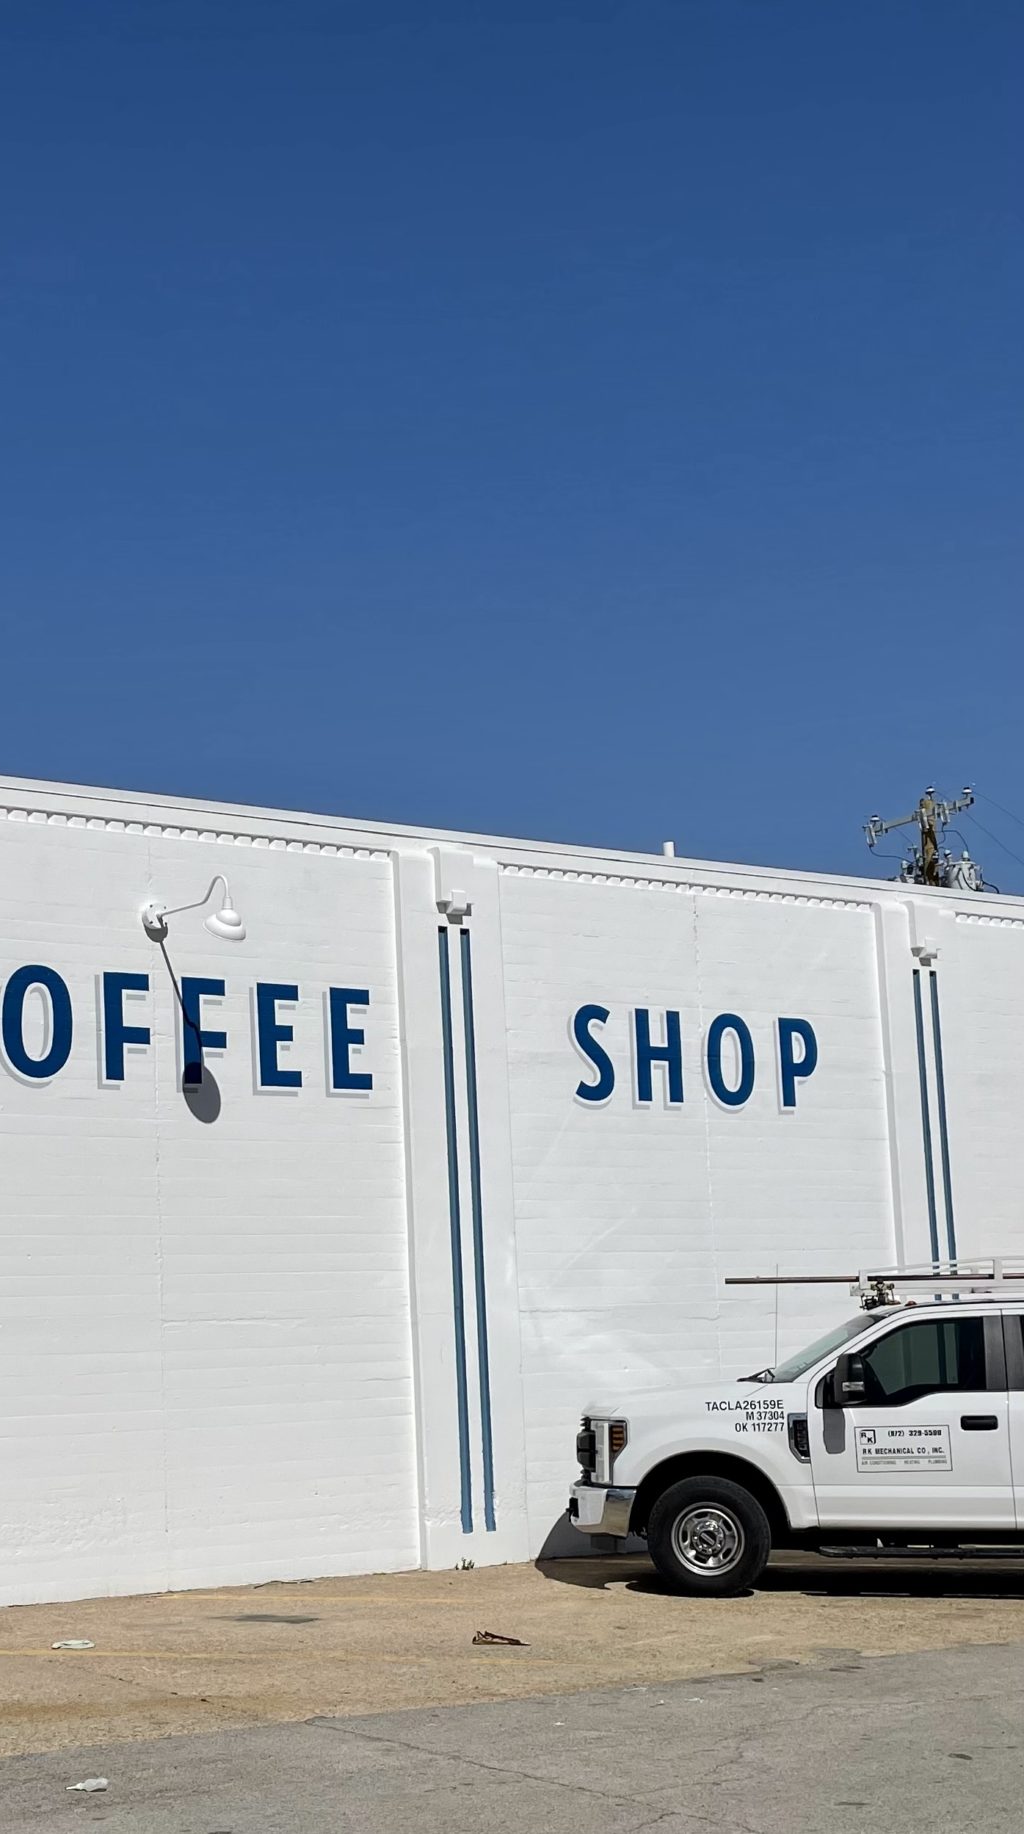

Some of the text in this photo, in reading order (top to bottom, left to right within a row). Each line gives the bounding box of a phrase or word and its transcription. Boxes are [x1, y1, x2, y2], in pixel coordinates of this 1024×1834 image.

[573, 1004, 818, 1107] SHOP
[705, 1399, 784, 1411] TACLA26159E
[745, 1410, 785, 1421] M 37304
[734, 1421, 785, 1433] OK 117277
[875, 1447, 915, 1455] MECHANICAL
